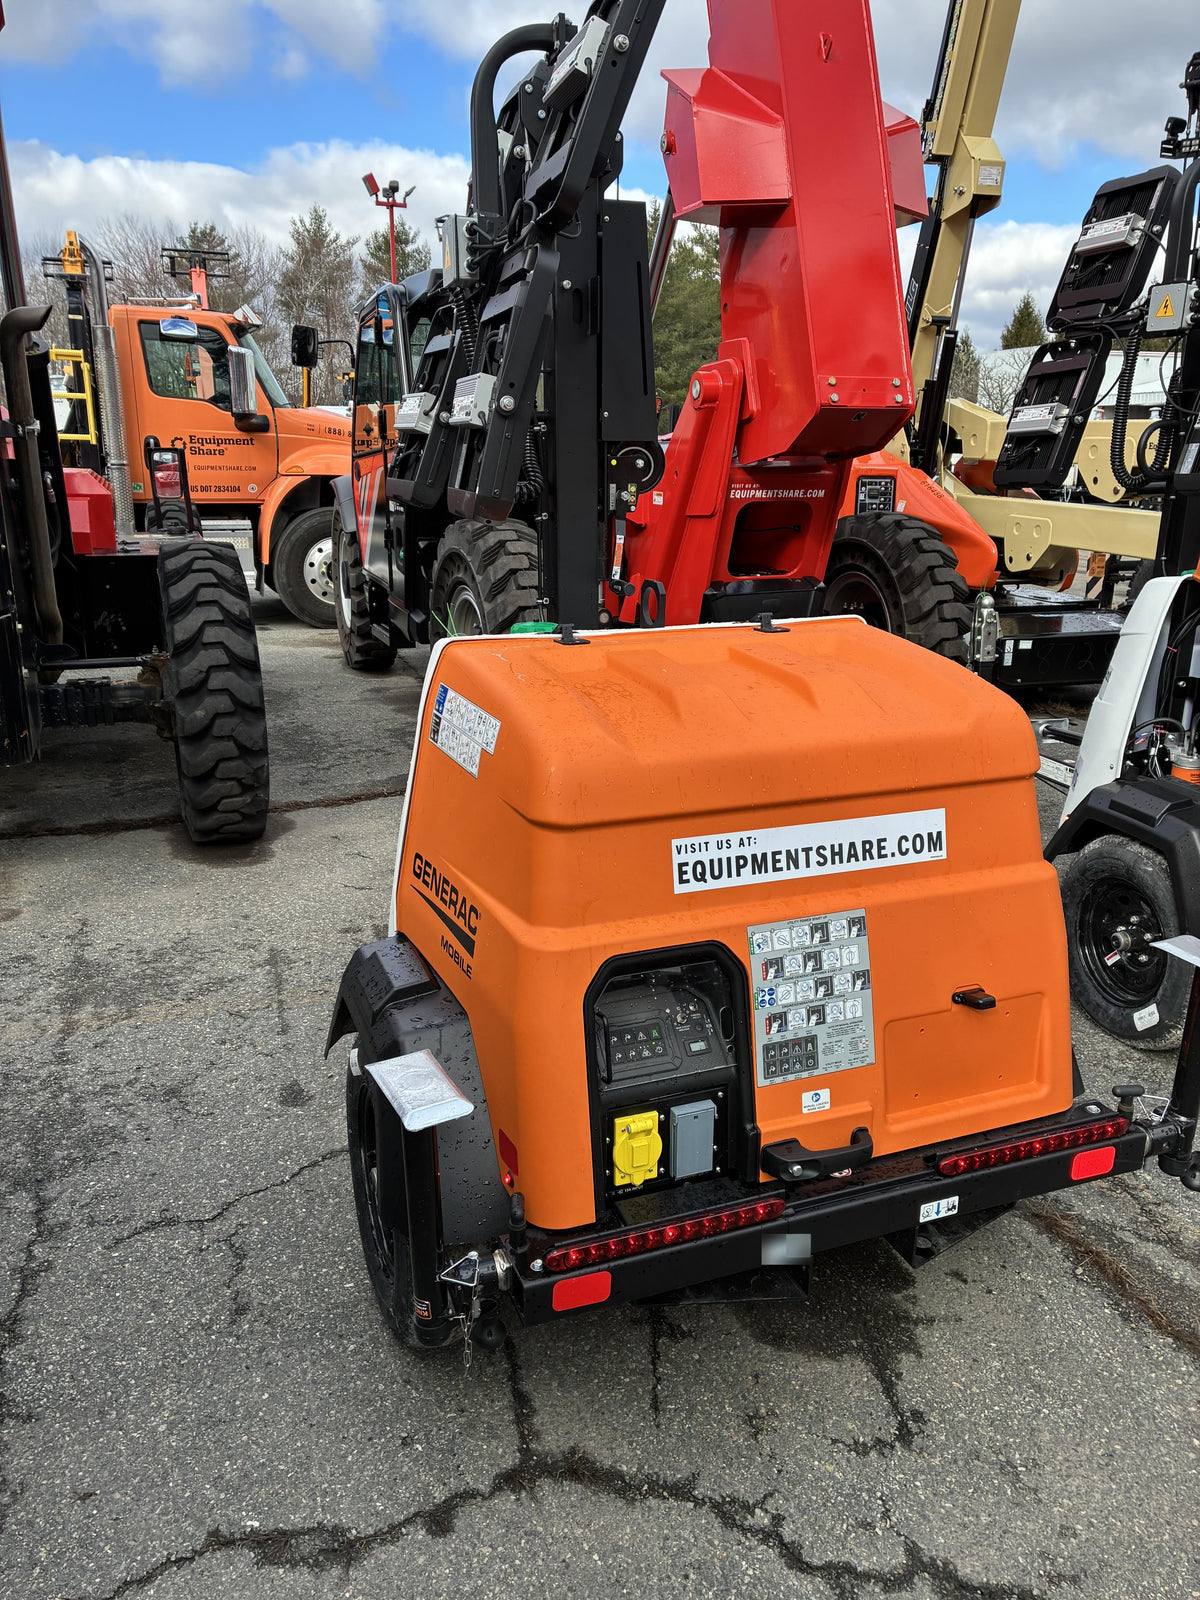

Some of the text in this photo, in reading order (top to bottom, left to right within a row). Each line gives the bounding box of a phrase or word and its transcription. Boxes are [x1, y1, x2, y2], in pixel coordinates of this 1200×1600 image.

[324, 426, 345, 437] (888)
[188, 434, 255, 447] Equipment
[213, 485, 241, 493] 2834104
[730, 489, 825, 498] EQUIPMENTSHARE.COM
[675, 836, 757, 855] VISIT US AT:
[677, 830, 943, 885] EQUIPMENTSHARE.COM
[412, 852, 479, 936] GENERAC
[440, 934, 472, 980] MOBILE
